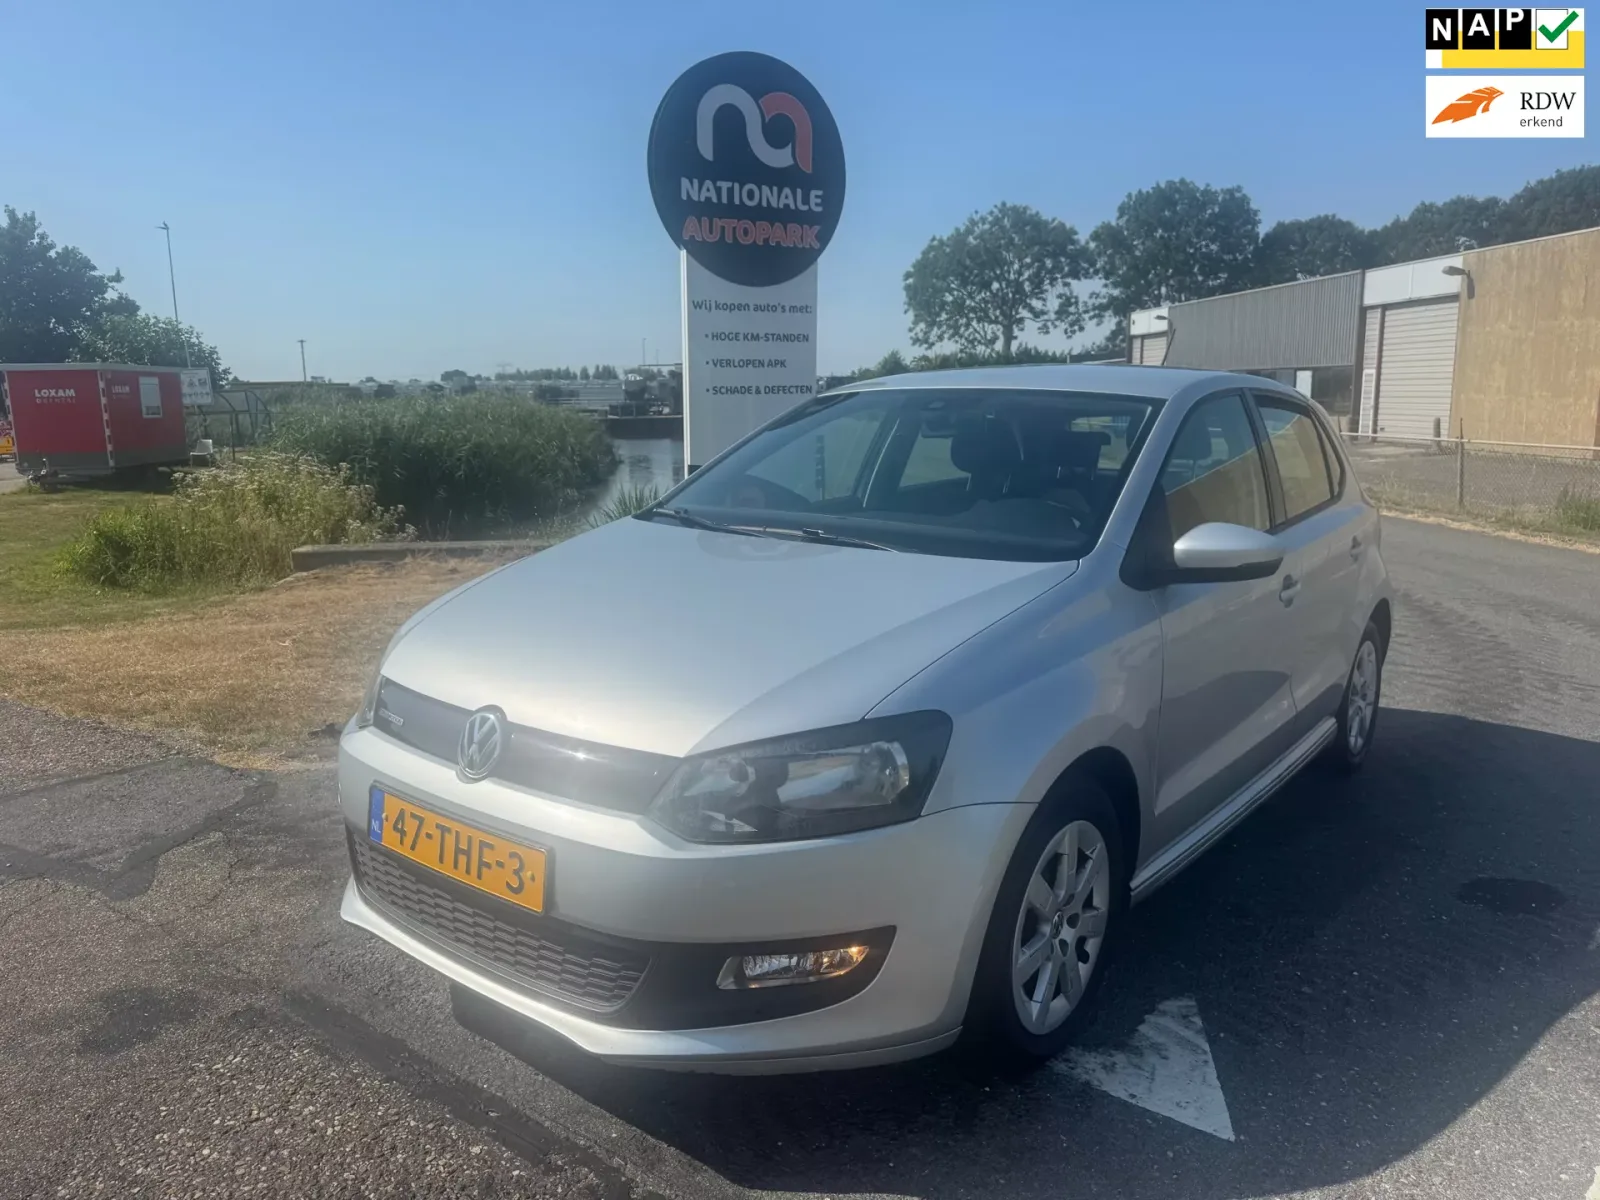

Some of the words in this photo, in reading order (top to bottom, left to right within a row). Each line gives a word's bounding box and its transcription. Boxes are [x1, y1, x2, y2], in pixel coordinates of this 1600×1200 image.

[680, 176, 824, 212] NATIONALE
[682, 215, 821, 249] AUTOPARK
[692, 299, 712, 313] Wij
[714, 300, 750, 313] kopen
[753, 302, 786, 313] auto's
[788, 303, 813, 314] met:
[711, 332, 741, 342] HOGE
[743, 332, 810, 343] KM-STANDEN
[712, 358, 765, 368] VERLOPEN
[767, 359, 787, 369] APK
[34, 388, 76, 398] LOXAM
[712, 385, 752, 395] SCHADE
[754, 386, 762, 395] &
[764, 385, 813, 395] DEFECTEN
[371, 819, 382, 834] NL
[392, 807, 526, 895] 47-THF-3
